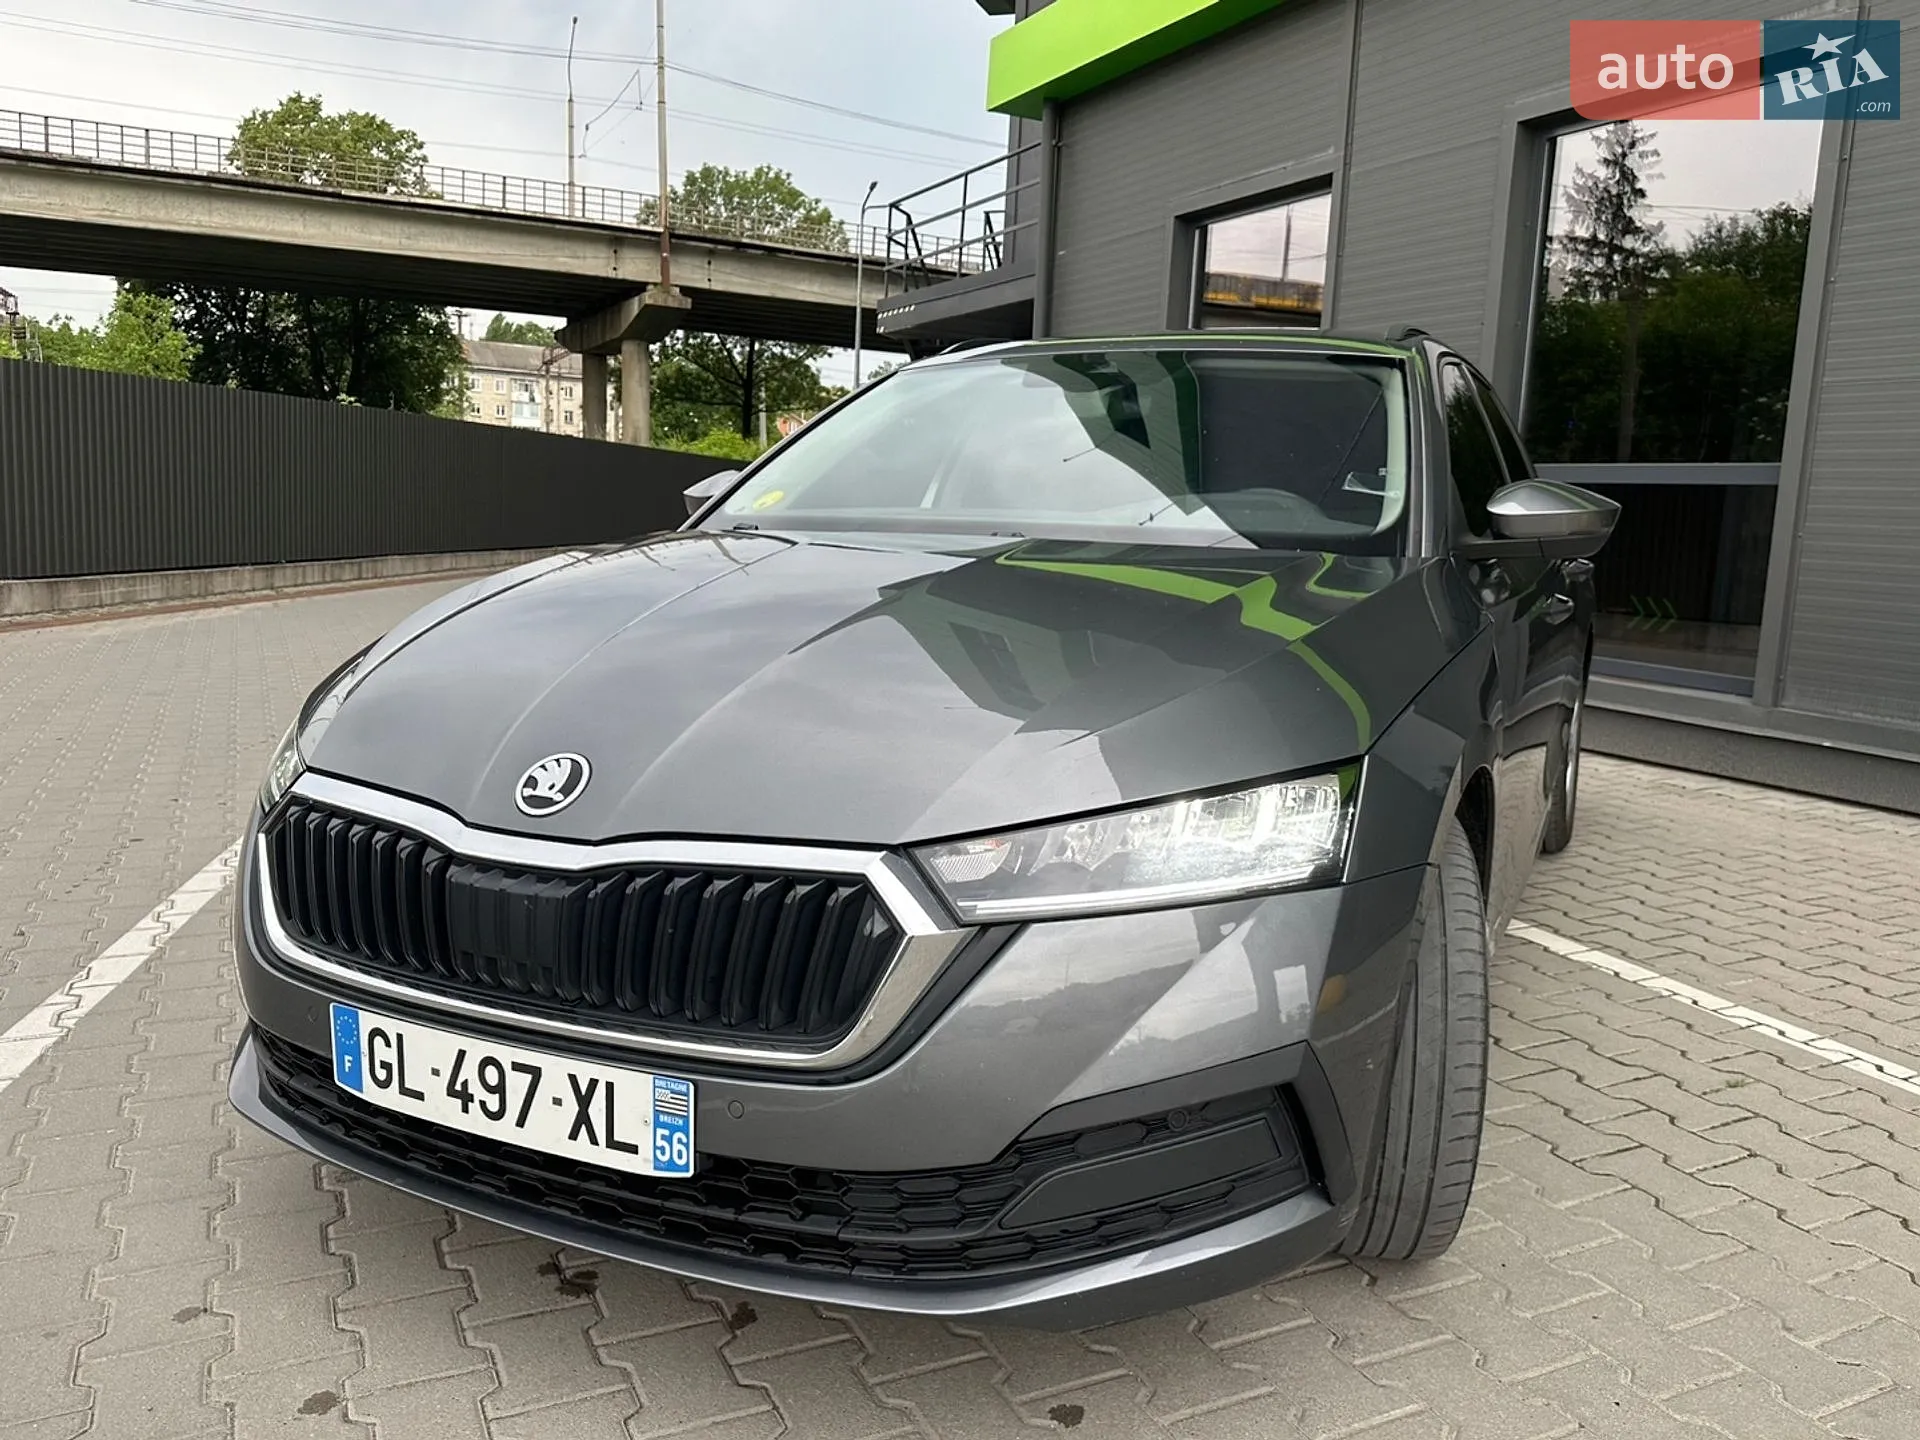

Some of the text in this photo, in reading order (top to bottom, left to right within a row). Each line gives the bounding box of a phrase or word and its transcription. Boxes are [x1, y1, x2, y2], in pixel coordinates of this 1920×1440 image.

[344, 1054, 353, 1073] F
[368, 1026, 639, 1156] GL-497-XL
[655, 1127, 688, 1166] 56
